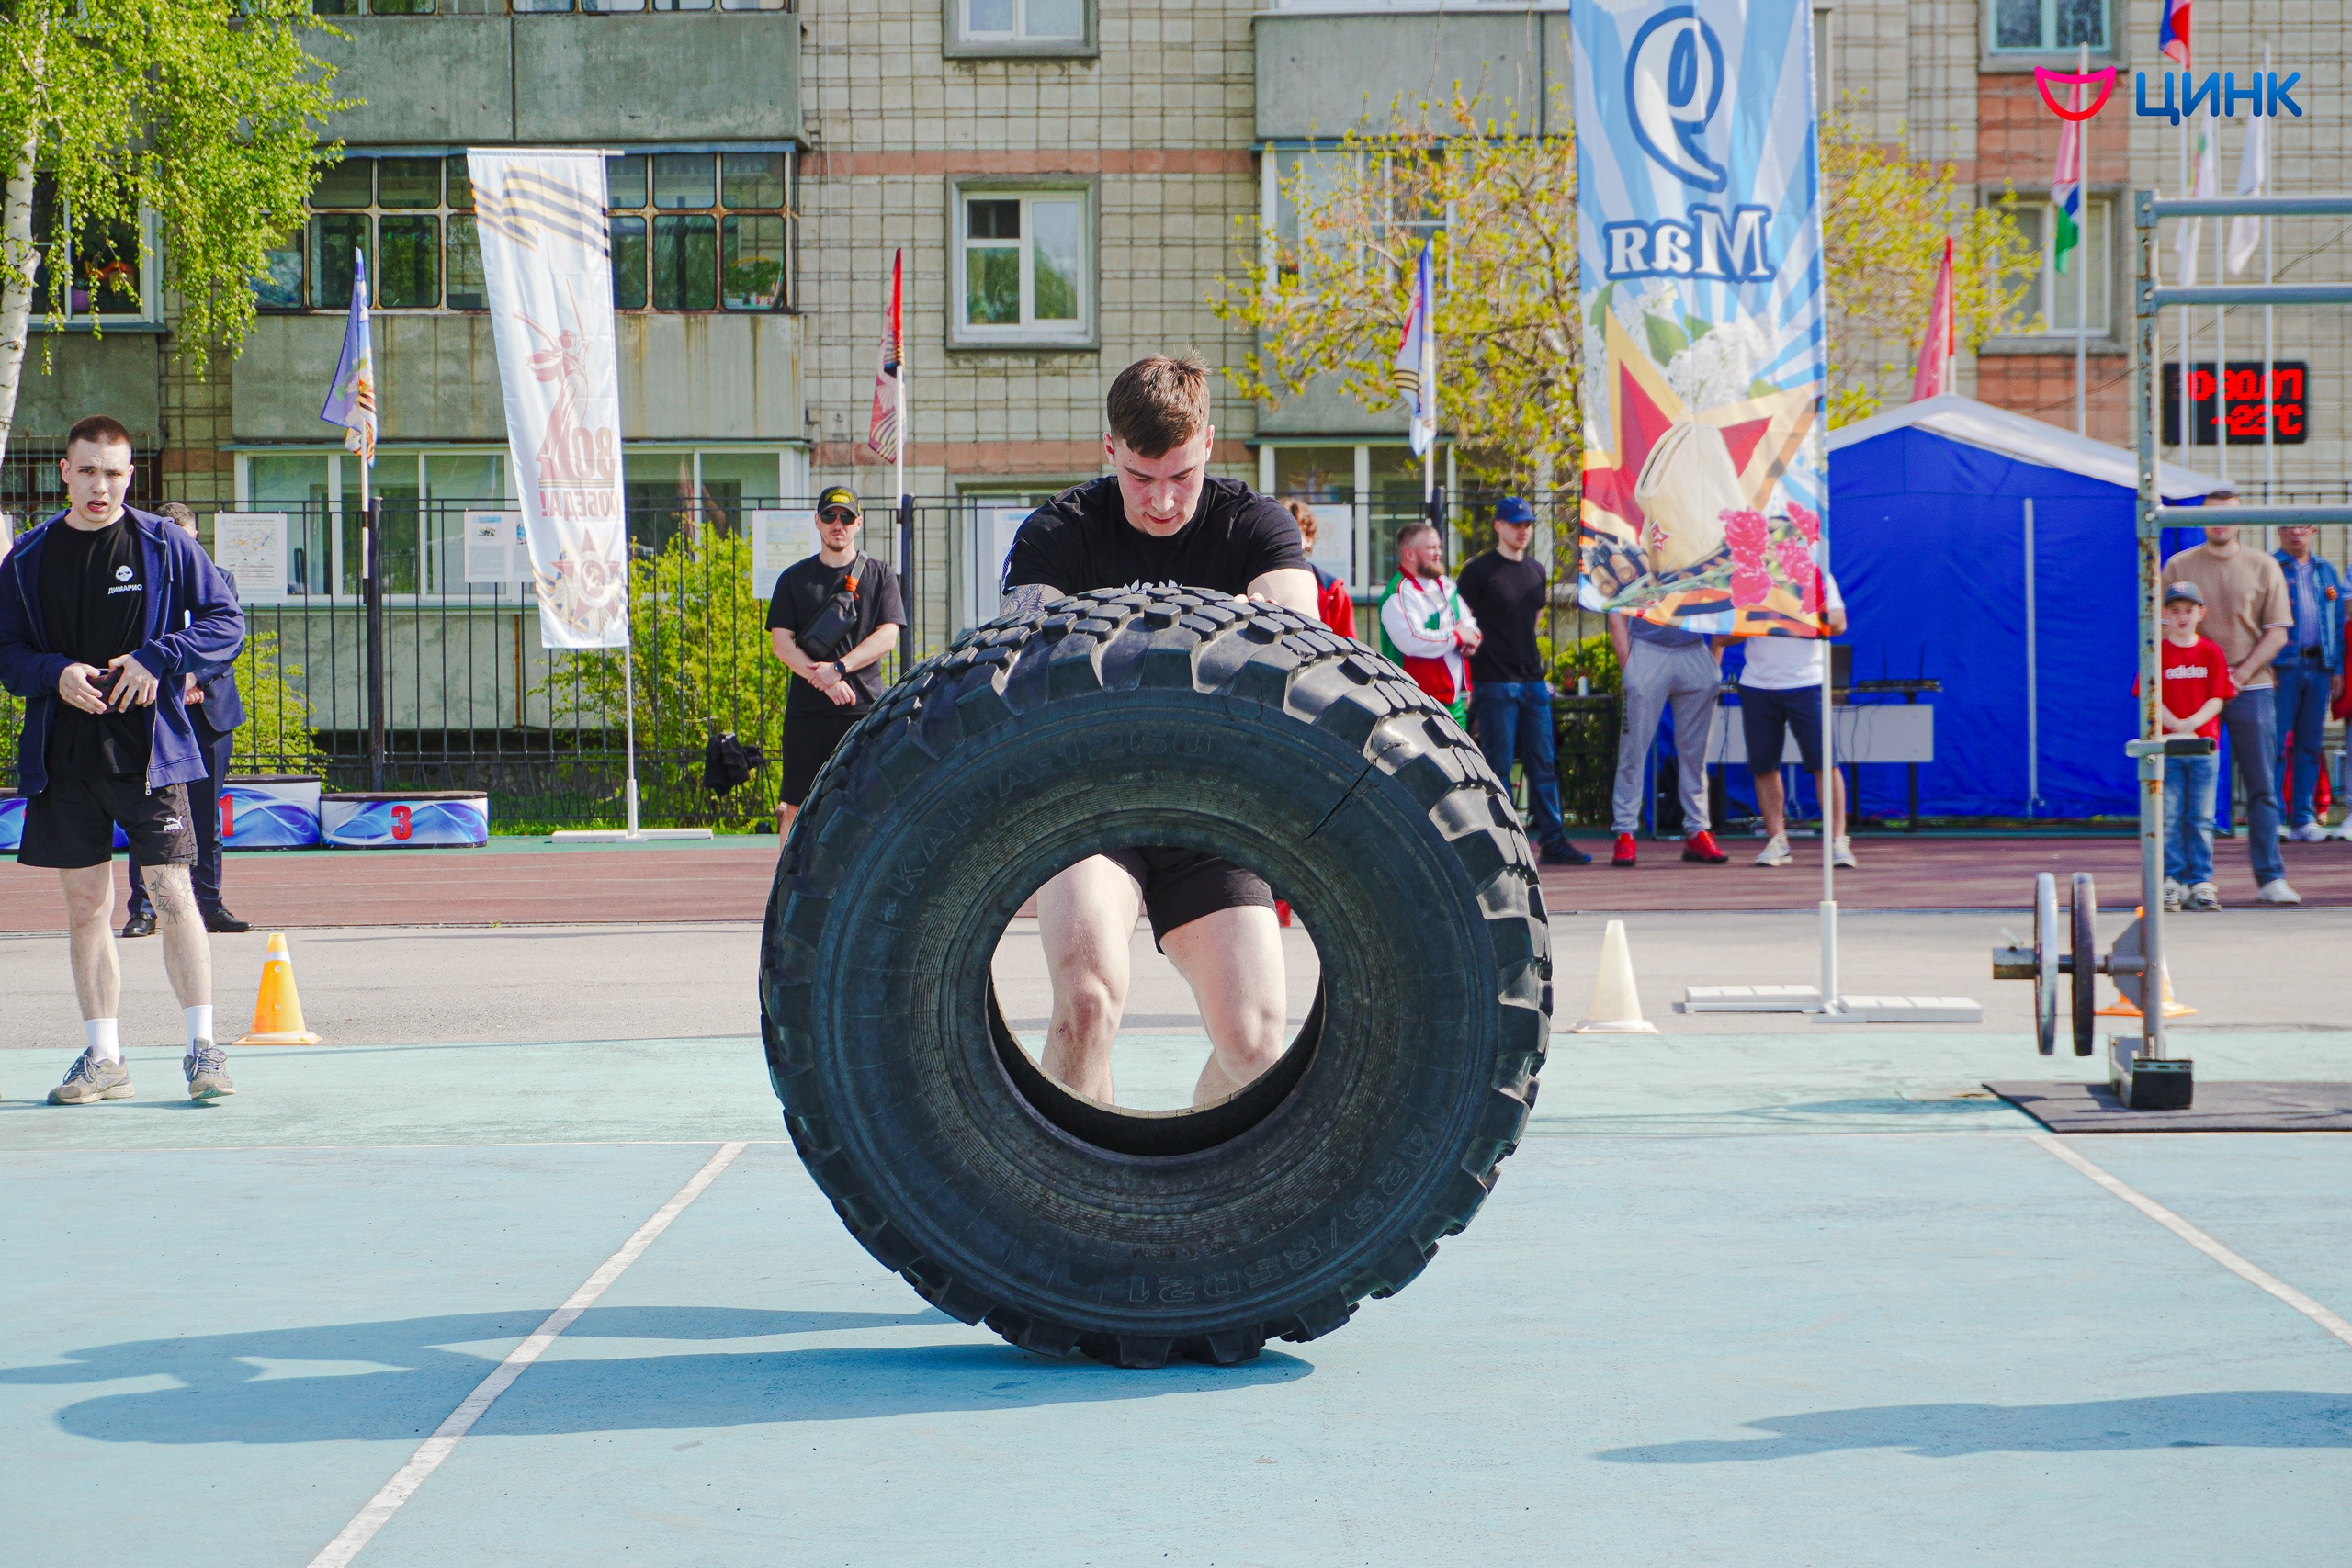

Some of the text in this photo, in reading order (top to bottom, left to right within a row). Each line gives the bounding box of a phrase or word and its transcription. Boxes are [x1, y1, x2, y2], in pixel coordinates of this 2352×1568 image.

[107, 583, 143, 595] ДИМАРИО
[218, 794, 234, 837] 1
[391, 805, 413, 840] 3
